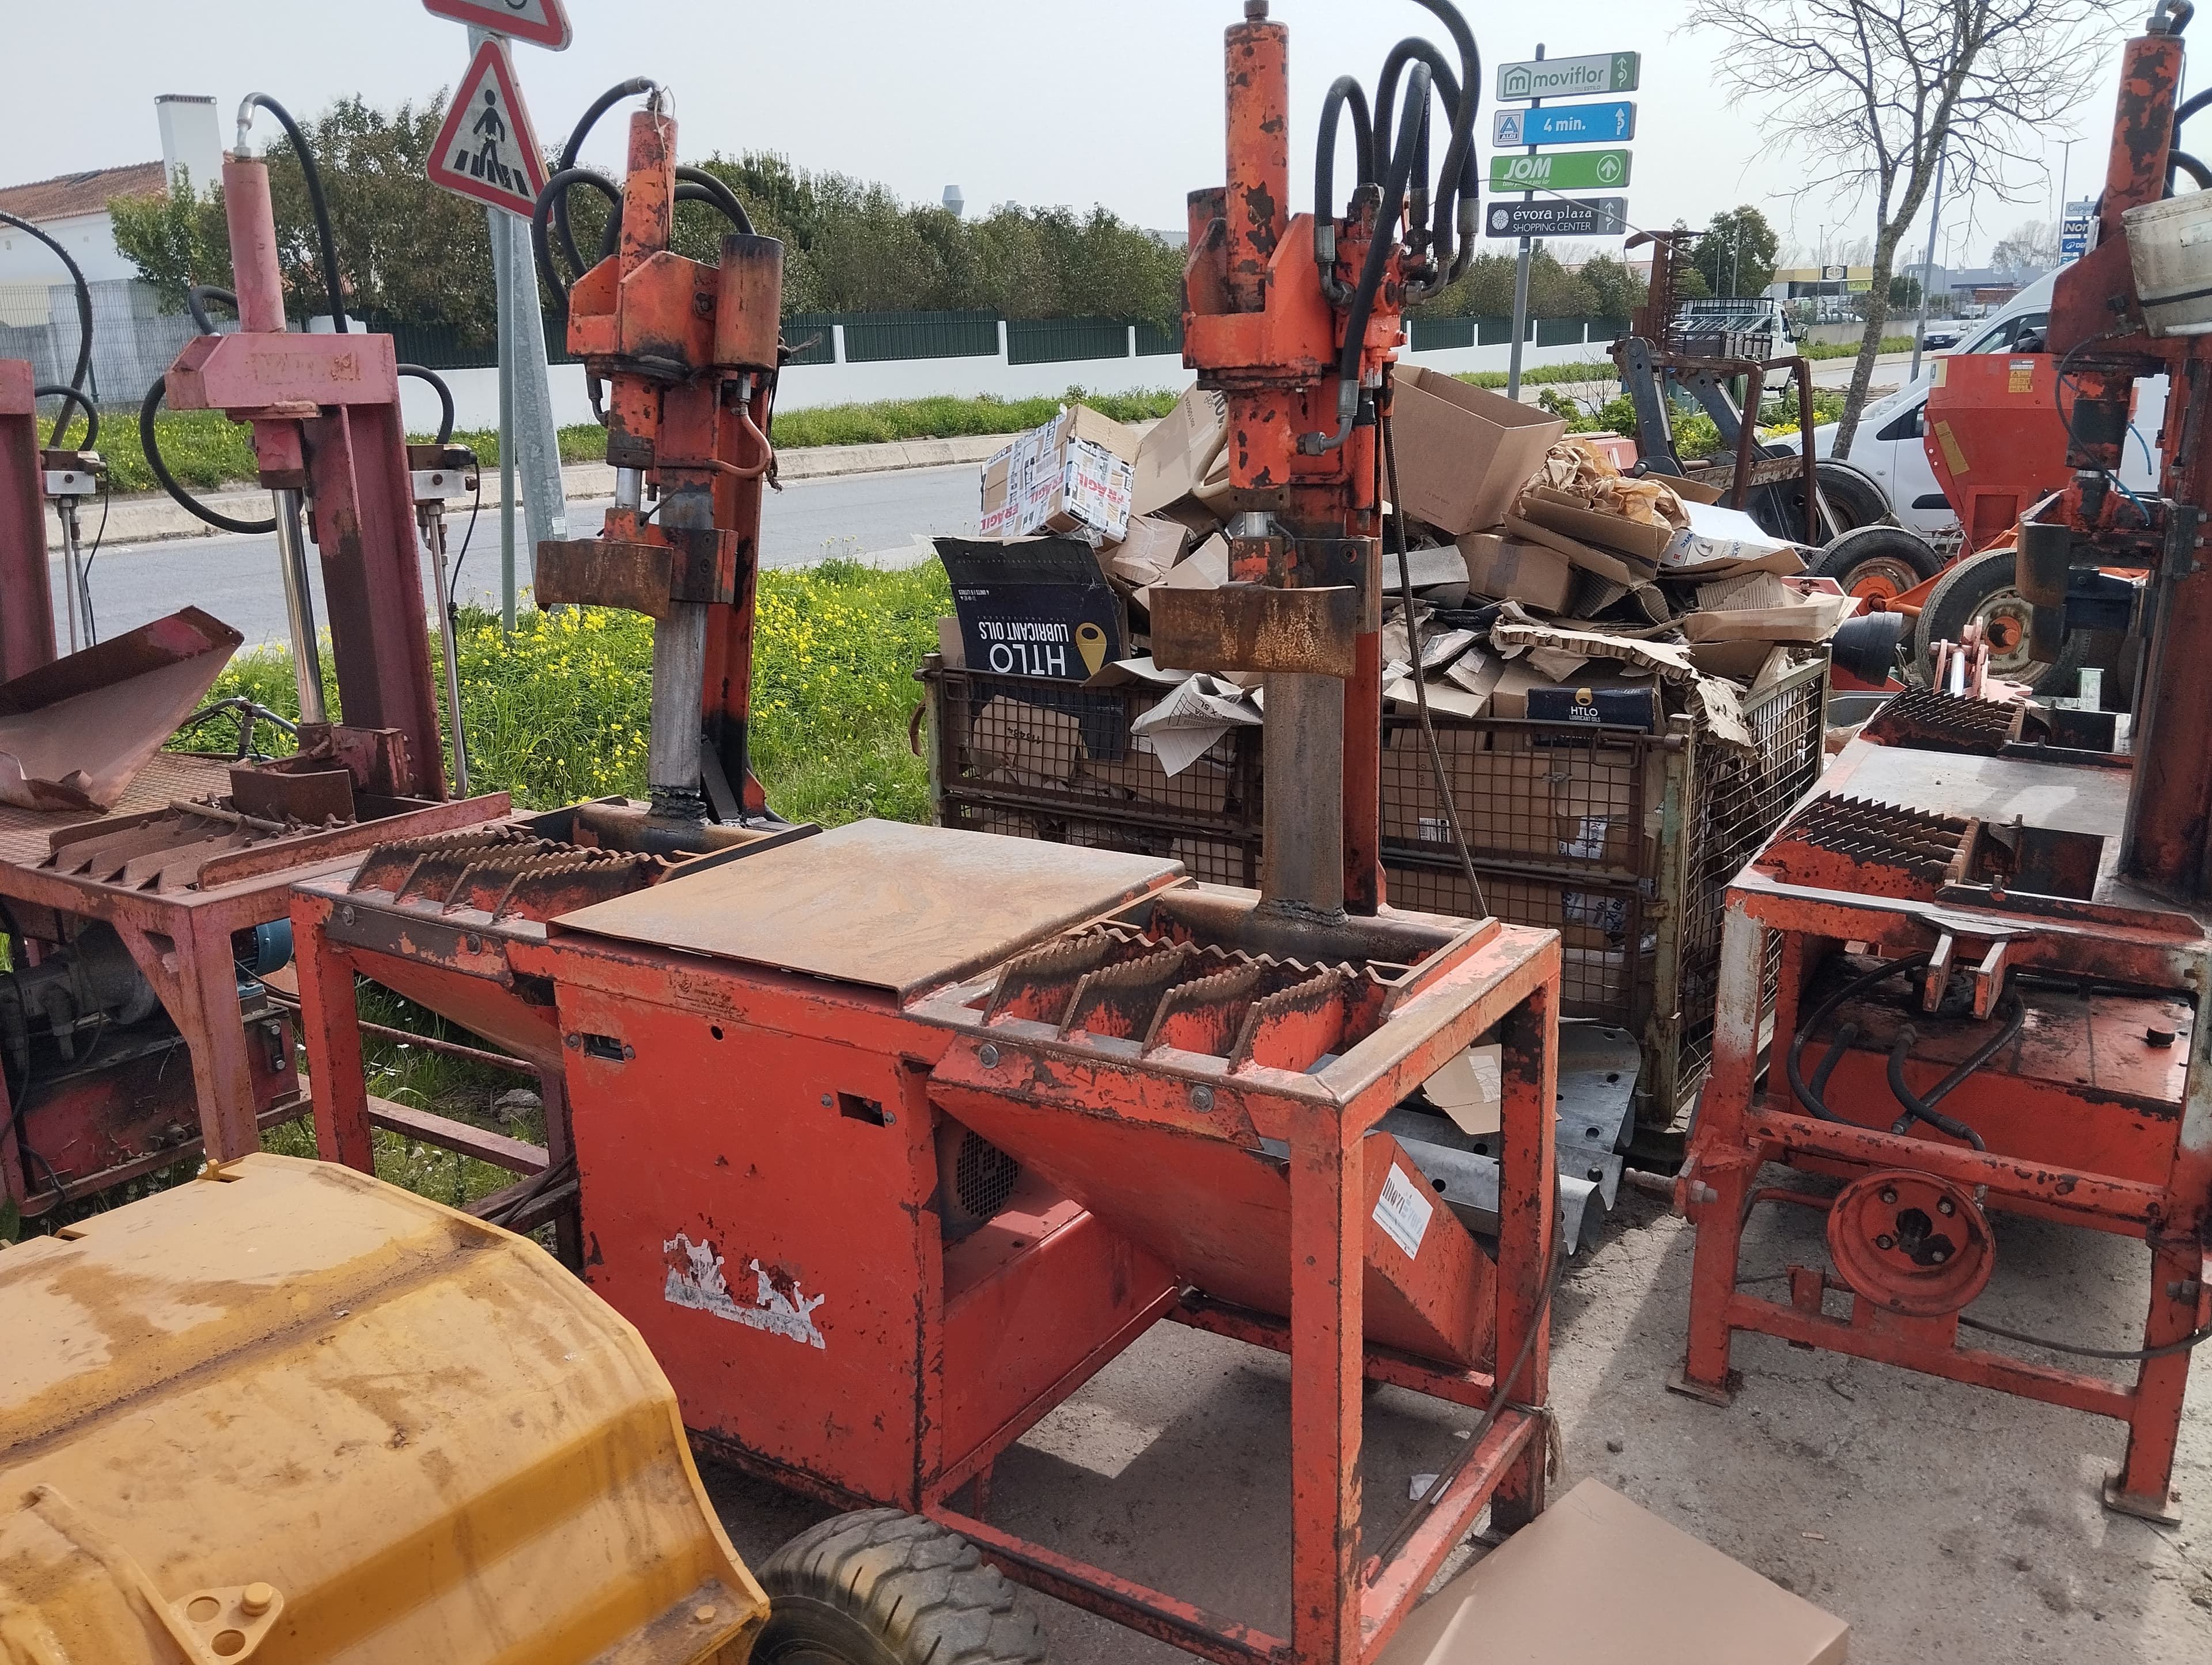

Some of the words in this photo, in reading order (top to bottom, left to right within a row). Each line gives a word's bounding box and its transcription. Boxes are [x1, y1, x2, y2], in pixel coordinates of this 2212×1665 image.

[1533, 66, 1604, 88] moviflor
[1543, 118, 1552, 132] 4
[1556, 116, 1586, 131] min.
[1503, 157, 1552, 179] JOM
[1513, 206, 1552, 220] évora
[1556, 205, 1592, 221] plaza
[1513, 222, 1556, 232] SHOPPING
[1556, 222, 1591, 232] CENTER
[979, 621, 1005, 640] OILS
[1006, 622, 1069, 642] LUBRICANT
[990, 643, 1066, 676] HTLO
[1570, 706, 1598, 716] HTLO
